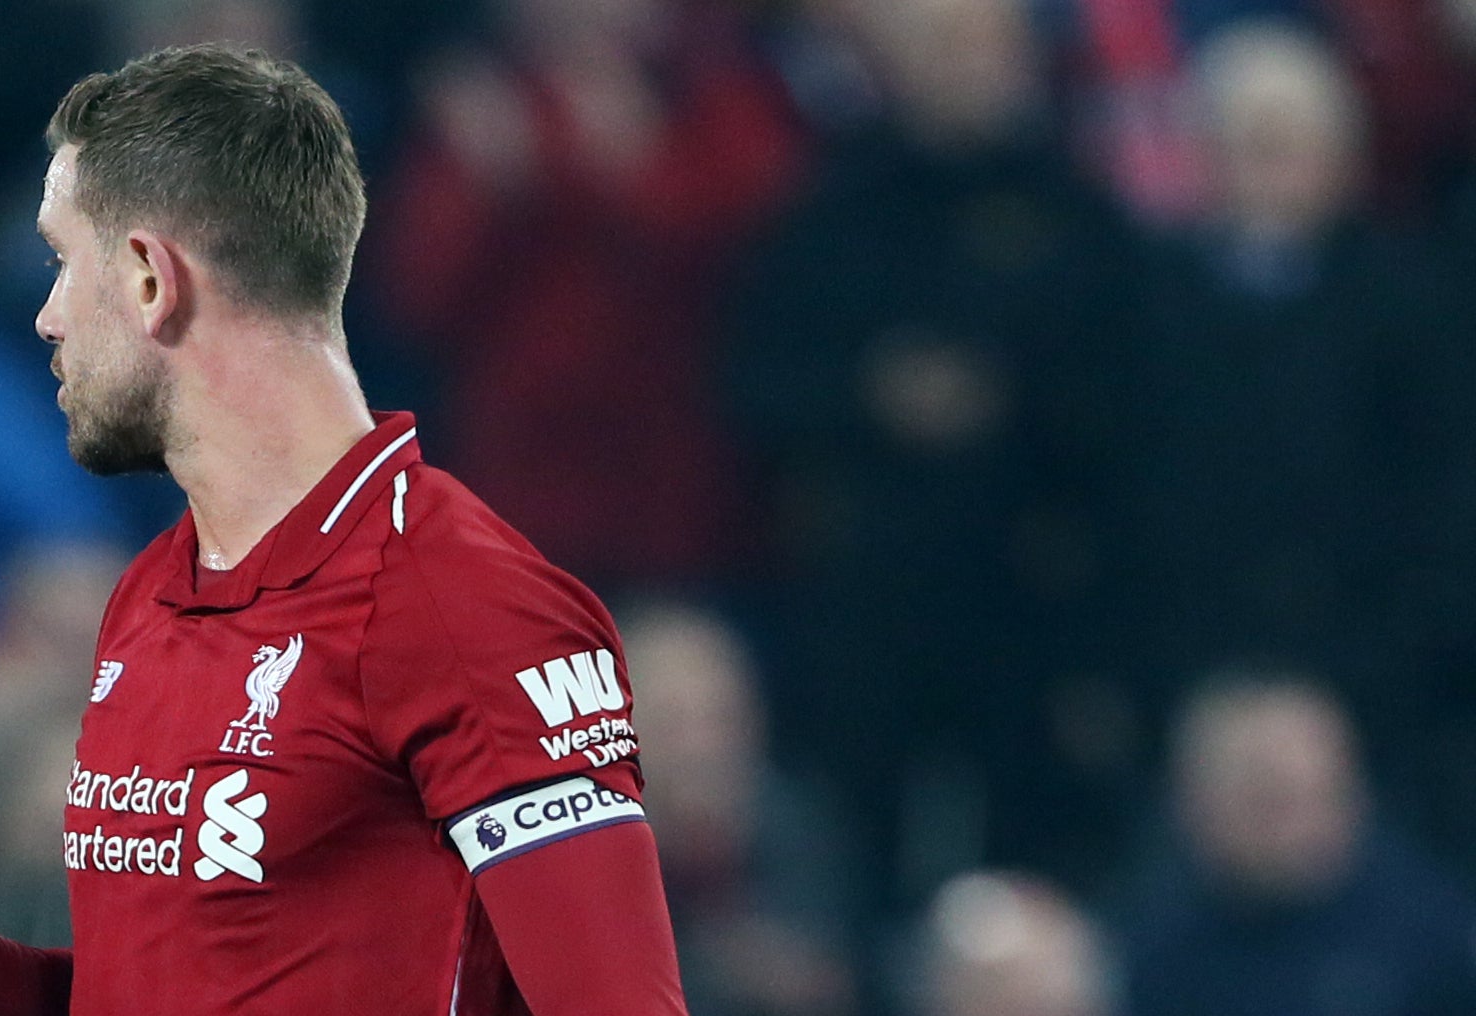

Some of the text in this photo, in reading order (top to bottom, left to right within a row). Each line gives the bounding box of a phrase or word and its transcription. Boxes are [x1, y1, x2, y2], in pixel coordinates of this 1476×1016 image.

[67, 760, 195, 816] tandard
[513, 785, 636, 831] Capta
[63, 825, 184, 877] artered
